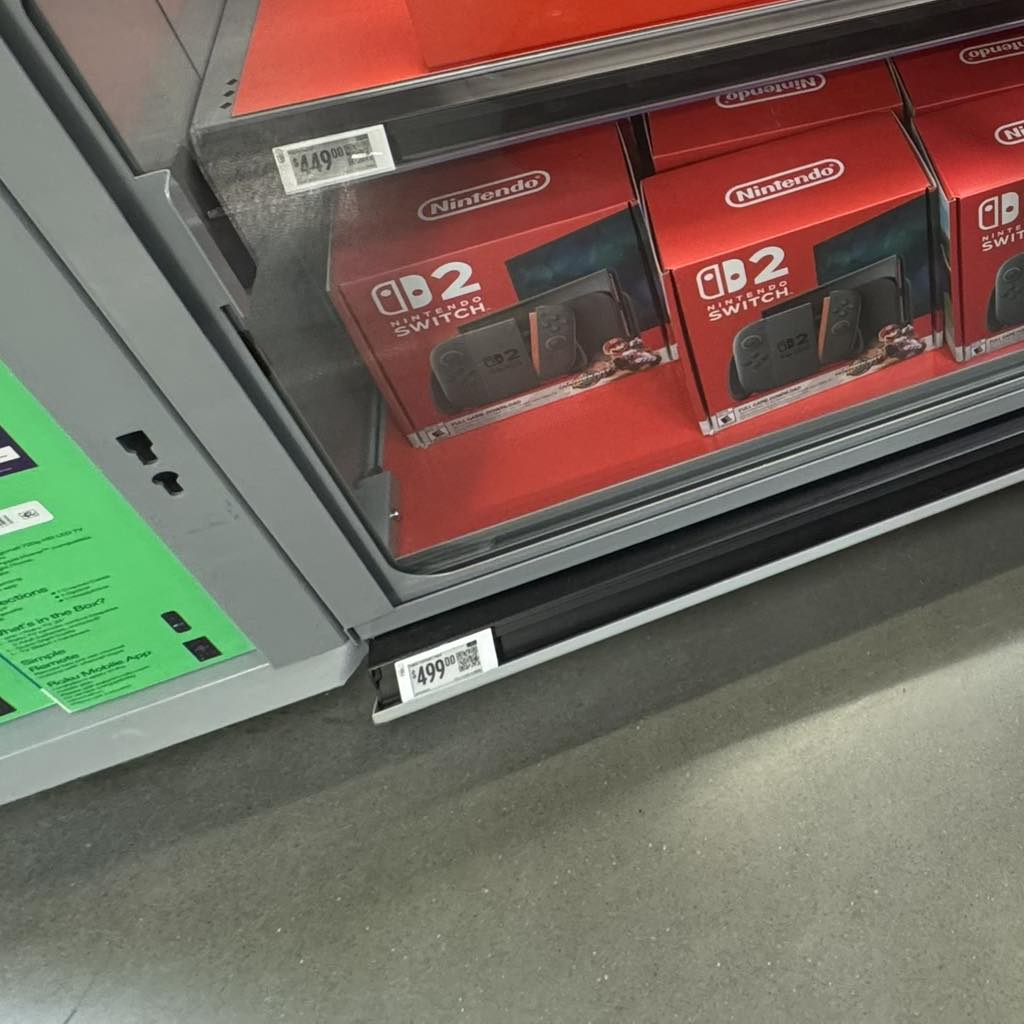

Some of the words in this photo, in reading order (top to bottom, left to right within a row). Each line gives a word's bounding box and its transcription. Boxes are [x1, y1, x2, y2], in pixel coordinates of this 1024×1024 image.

[431, 261, 481, 301] 2
[749, 246, 789, 285] 2
[390, 296, 482, 327] NINTENDO
[707, 280, 788, 311] NINTENDO
[708, 287, 789, 322] SWITCH
[394, 302, 486, 337] SWITCH
[73, 597, 105, 613] Box?
[81, 660, 125, 676] Mobile
[126, 650, 152, 662] App
